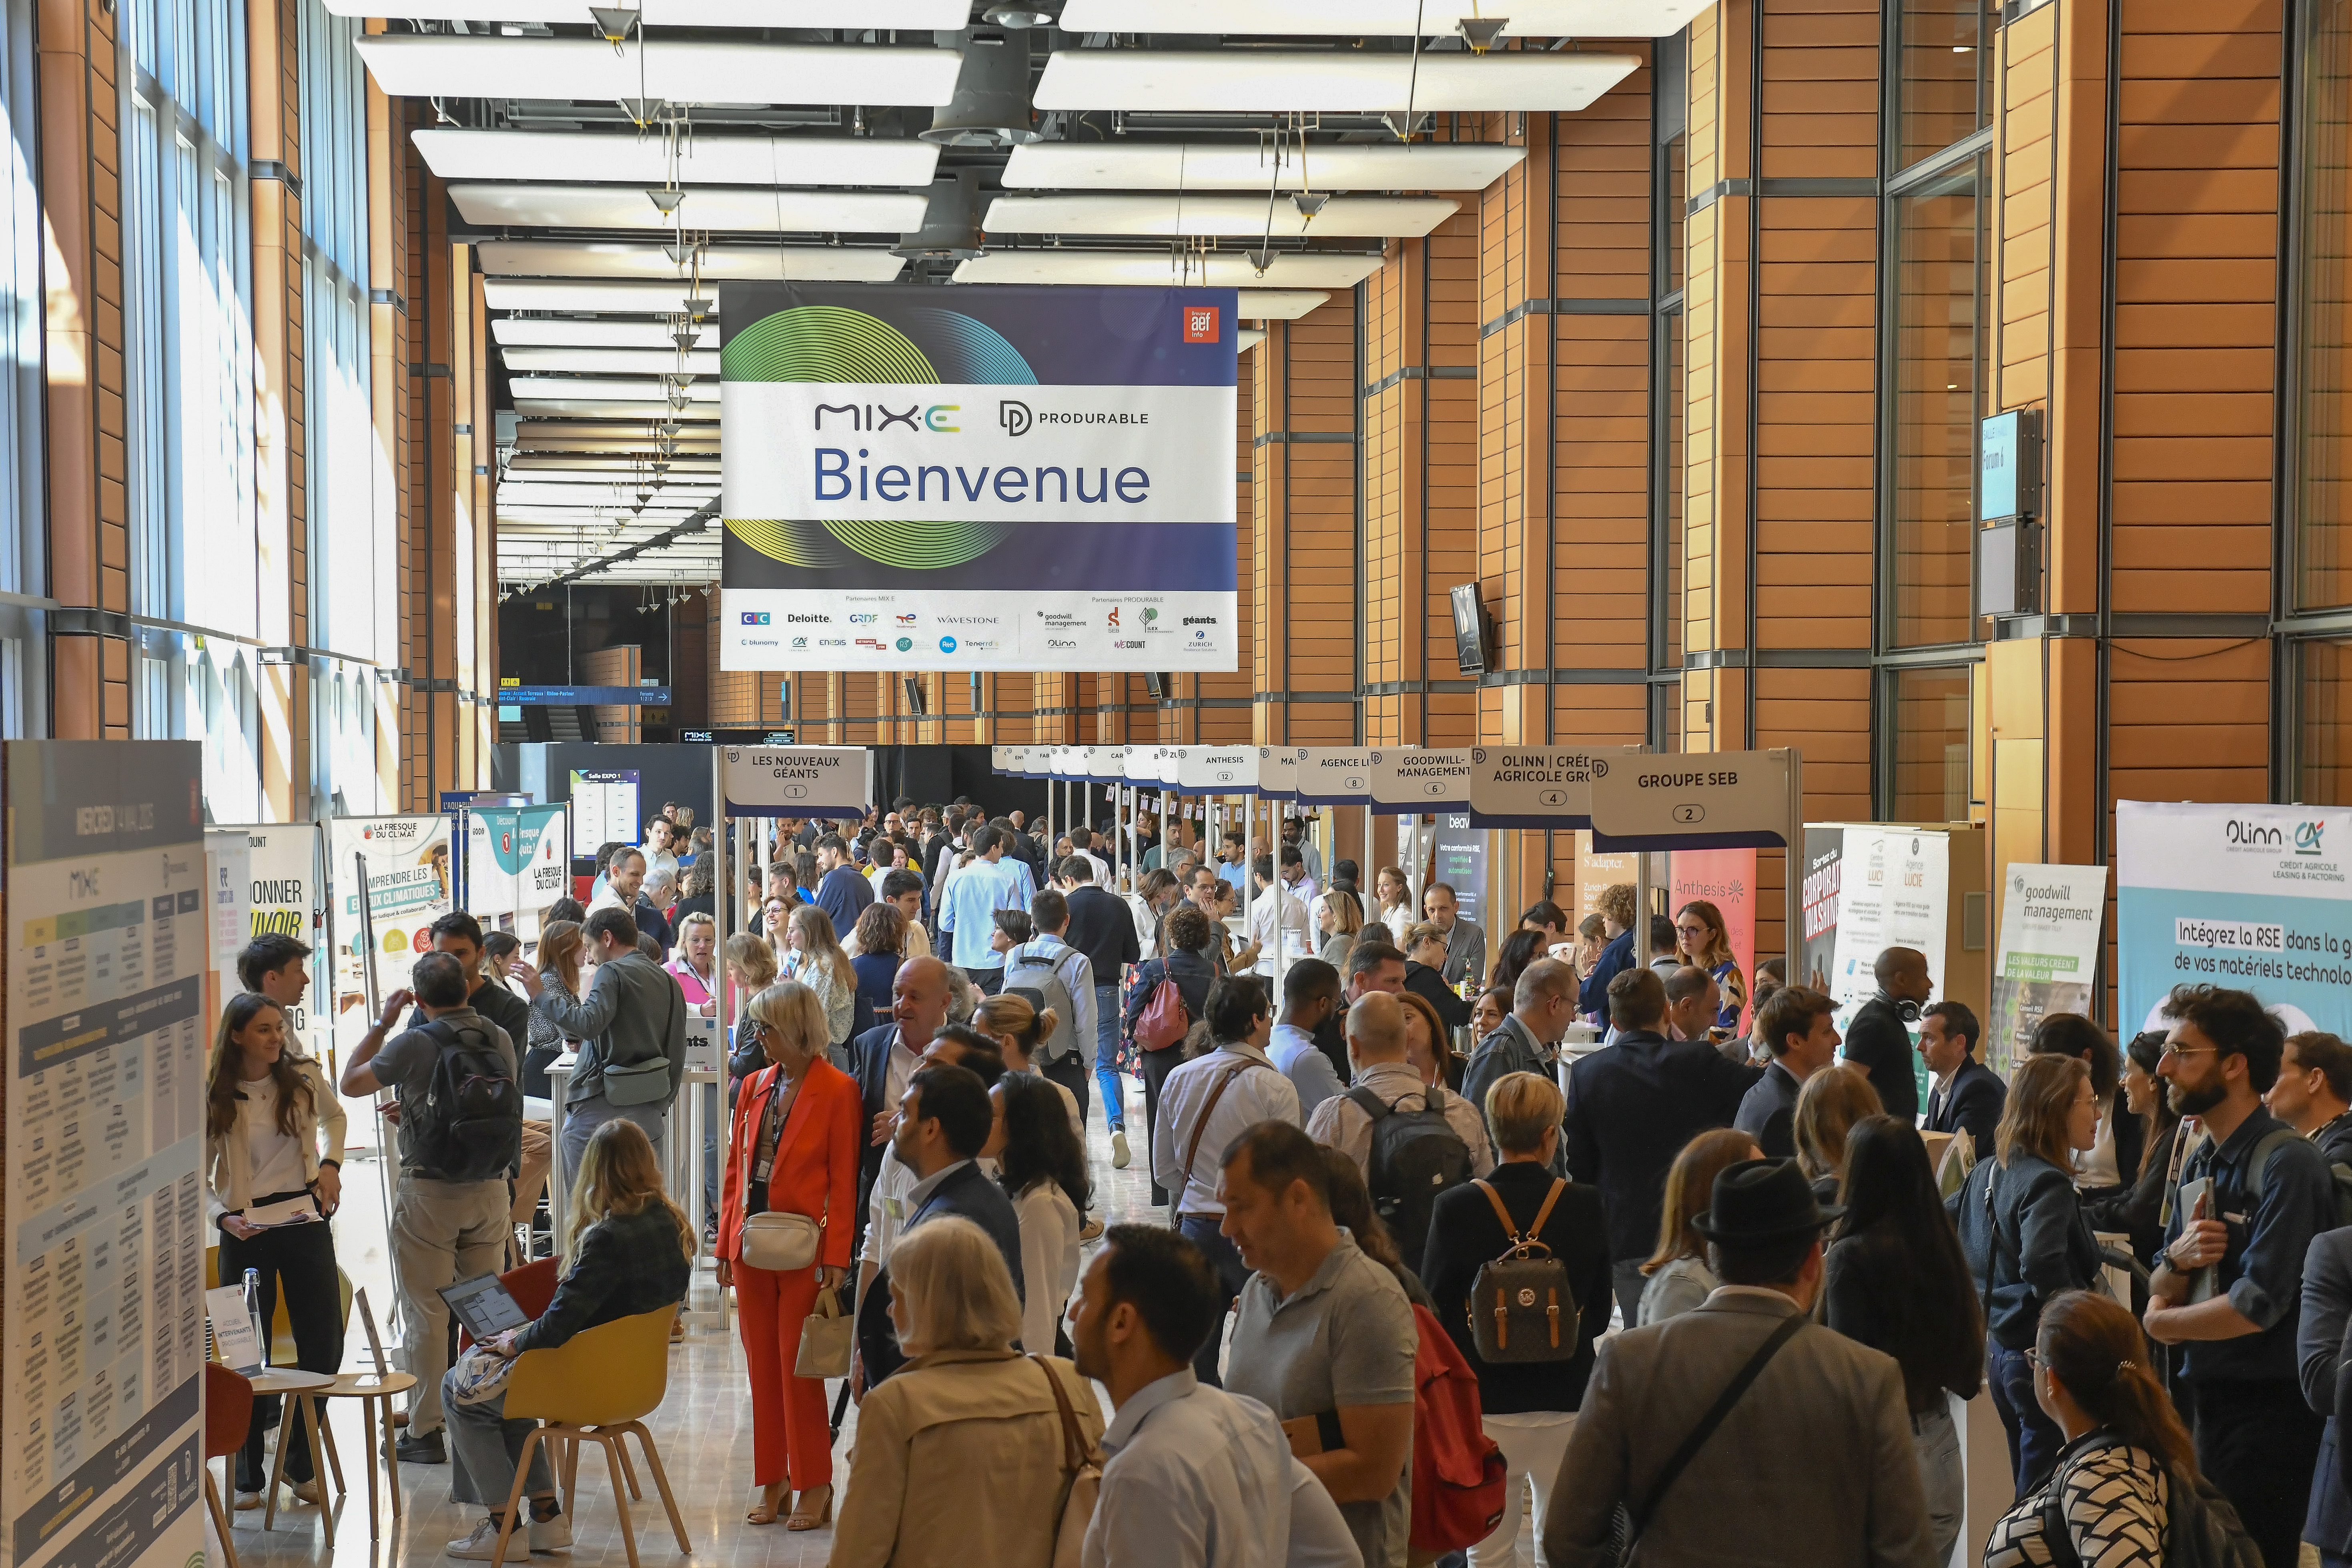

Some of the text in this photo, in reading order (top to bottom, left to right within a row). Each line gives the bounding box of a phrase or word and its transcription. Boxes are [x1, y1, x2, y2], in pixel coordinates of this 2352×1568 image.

[1191, 312, 1211, 331] aef
[1039, 413, 1149, 424] PRODURABLE
[1983, 449, 1999, 471] Forum
[814, 448, 1151, 503] Bienvenue
[743, 614, 768, 624] CIC
[850, 614, 878, 623] GRDF
[937, 615, 999, 624] WAVESTONE
[753, 756, 840, 766] LES NOUVEAUX
[1320, 759, 1359, 767] AGENCE
[1403, 755, 1465, 765] GOODWILL-
[1502, 756, 1544, 767] OLINN
[773, 767, 819, 778] GÉANTS
[1397, 766, 1470, 777] MANAGEMENT
[1493, 770, 1562, 782] AGRICOLE
[1638, 772, 1738, 788] GROUPE SEB
[794, 788, 797, 796] 1
[1549, 794, 1557, 803] 4
[1685, 809, 1693, 820] 2
[385, 823, 417, 831] FRESQUE
[1451, 844, 1472, 852] conformité
[1584, 856, 1624, 871] S'adapter.
[1813, 848, 1837, 870] Sortez du
[1906, 860, 1923, 871] Agence
[2280, 860, 2337, 871] CRÉDIT AGRICOLE
[534, 866, 561, 878] LA FRESQUE
[2273, 871, 2300, 879] LEASING
[2308, 873, 2344, 882] FACTORING
[368, 868, 427, 889] MPRENDRE LES
[1803, 859, 1841, 908] CORPORAT
[1904, 873, 1923, 887] LUCIE
[536, 880, 544, 890] DU
[1584, 883, 1601, 891] Zurich
[1675, 879, 1725, 897] Anthesis
[383, 884, 435, 905] CLIMATIQUES
[2026, 884, 2070, 902] goodwill
[378, 911, 395, 920] ludique
[401, 905, 426, 915] collaboratif
[2024, 905, 2093, 922] management
[1731, 926, 1743, 936] des
[2180, 921, 2338, 953] Intégrez la RSE dans la
[2009, 956, 2075, 969] LES VALEURS CRÉENT
[2174, 950, 2191, 970] de
[2194, 957, 2216, 972] vos
[2219, 955, 2282, 978] matériels
[2007, 968, 2049, 980] DE LA VALEUR
[218, 1326, 251, 1338] INTERVENANTS
